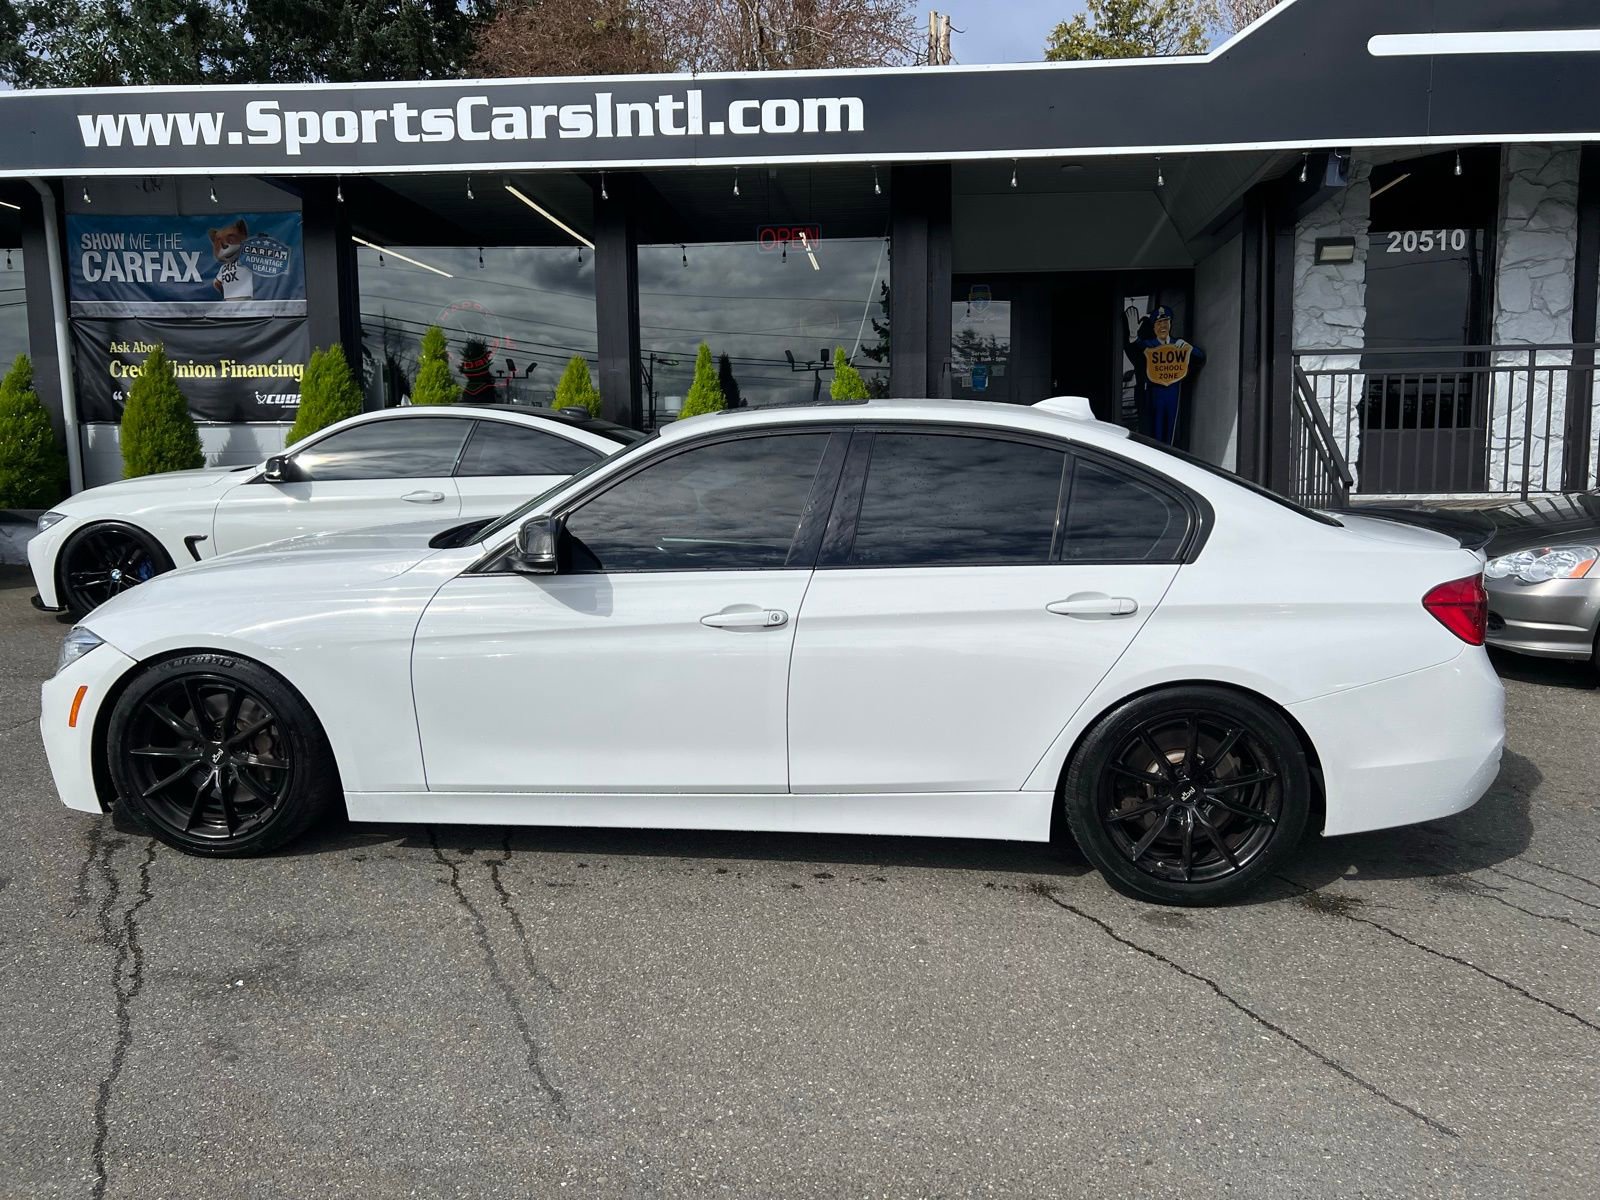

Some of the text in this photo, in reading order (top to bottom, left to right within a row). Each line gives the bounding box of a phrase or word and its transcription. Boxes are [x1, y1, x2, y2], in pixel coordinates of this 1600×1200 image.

[77, 89, 865, 155] www.SportsCarsIntl.com
[80, 232, 183, 250] SHOW ME THE
[759, 225, 820, 250] OPEN
[1386, 228, 1466, 253] 20510
[244, 245, 288, 260] CARFAX
[81, 251, 203, 283] CARFAX
[245, 255, 283, 268] ADVANTAGE
[252, 264, 277, 274] DEALER
[222, 271, 239, 283] FOX
[109, 341, 131, 353] Ask
[1151, 349, 1188, 365] SLOW
[109, 359, 150, 378] Cred
[220, 360, 305, 381] Financing
[1154, 364, 1184, 373] SCHOOL
[1158, 372, 1179, 380] ZONE
